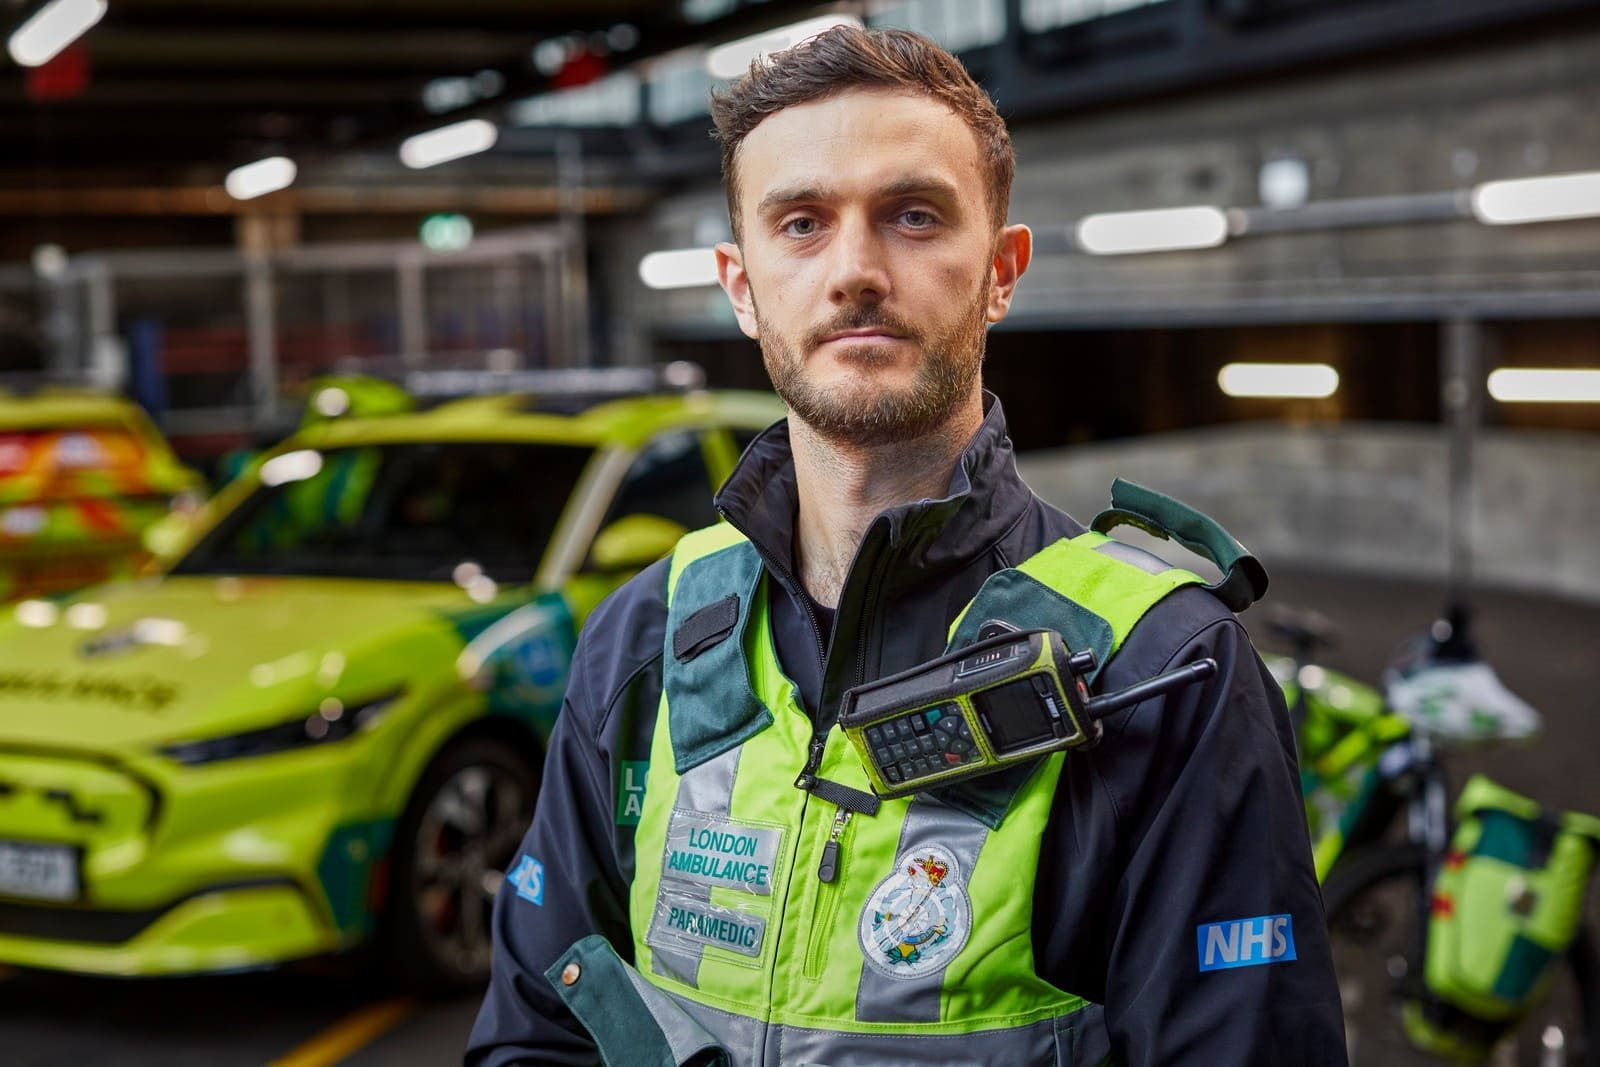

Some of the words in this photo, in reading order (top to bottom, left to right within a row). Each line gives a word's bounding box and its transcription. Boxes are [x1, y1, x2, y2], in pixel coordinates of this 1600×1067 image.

[624, 767, 650, 792] L
[688, 827, 758, 857] LONDON
[668, 850, 769, 886] AMBULANCE
[668, 906, 756, 948] PARAMEDIC
[1204, 917, 1288, 966] NHS
